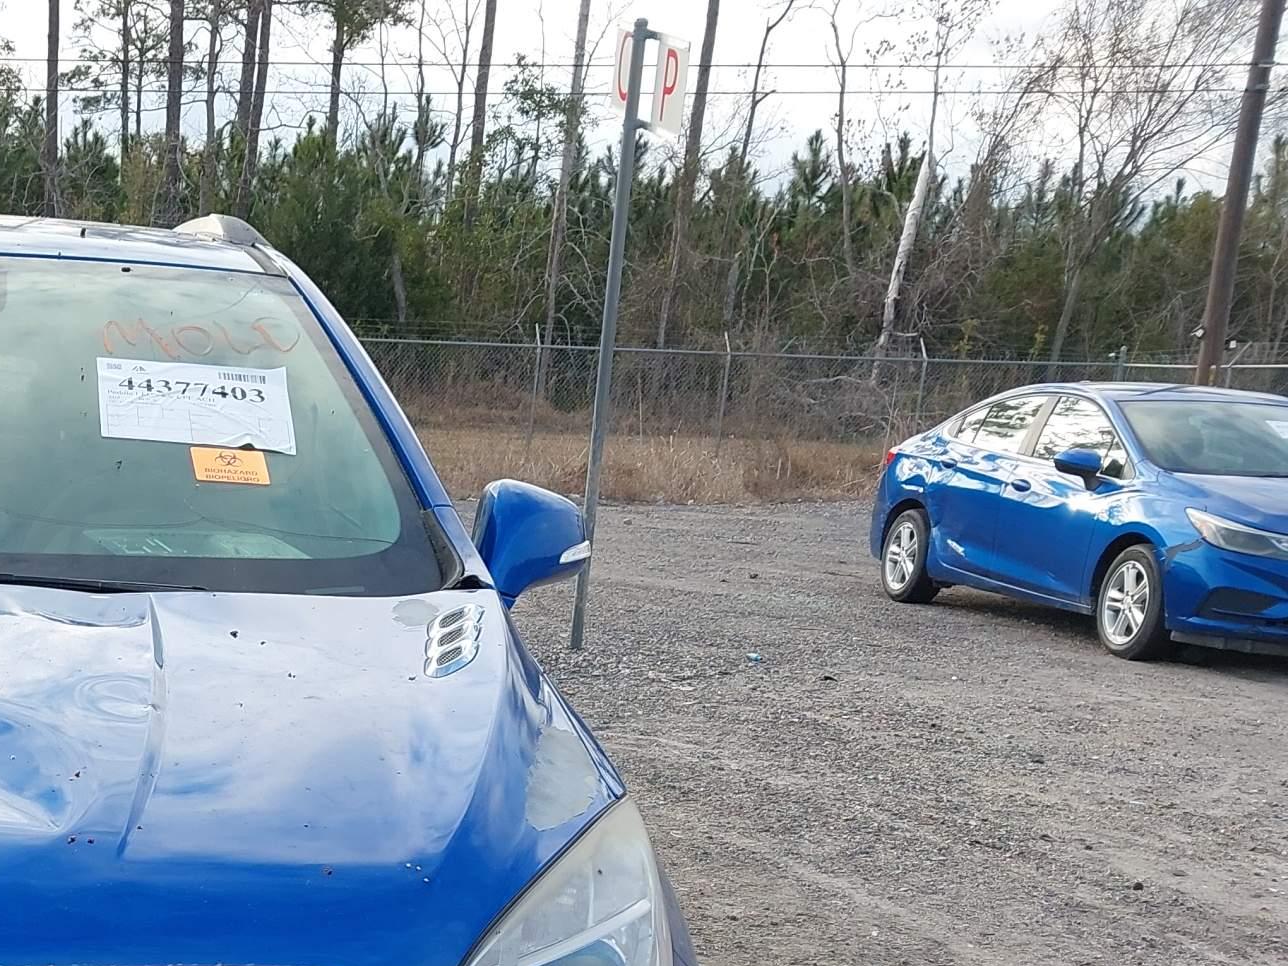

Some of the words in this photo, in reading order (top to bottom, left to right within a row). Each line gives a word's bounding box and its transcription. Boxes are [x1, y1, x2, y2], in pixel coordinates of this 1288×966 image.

[659, 47, 679, 122] P
[118, 376, 266, 404] 44377403
[204, 467, 258, 476] BIOHAZARD
